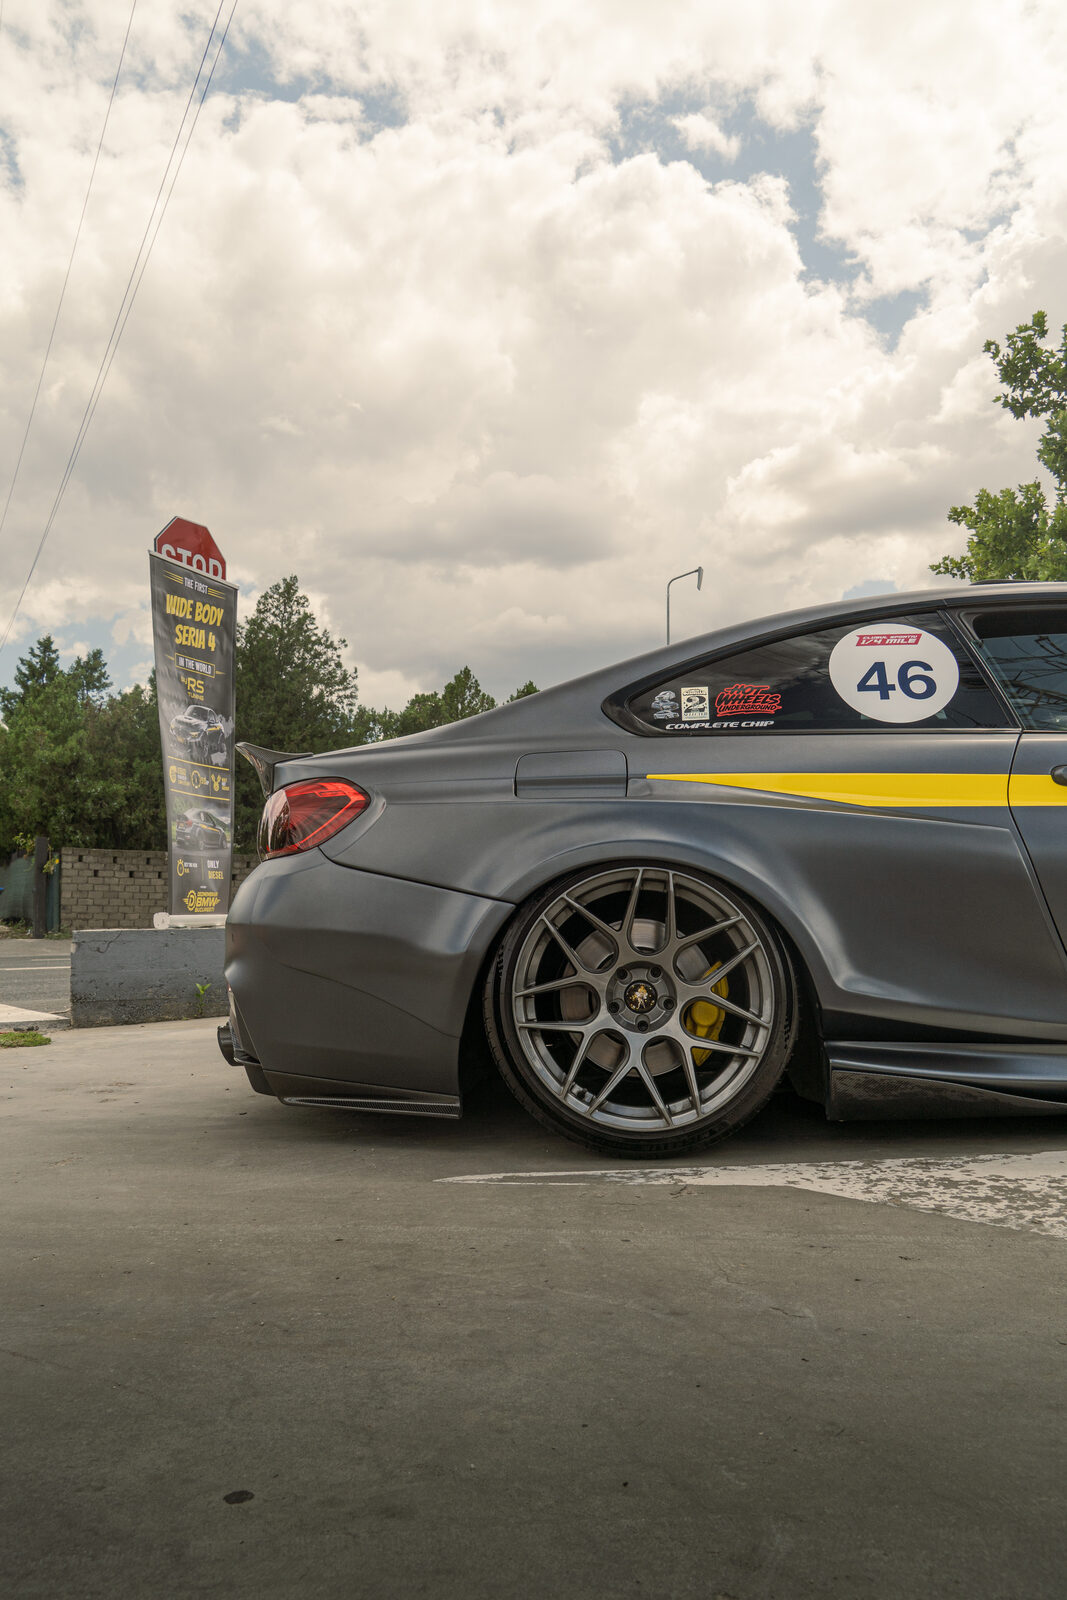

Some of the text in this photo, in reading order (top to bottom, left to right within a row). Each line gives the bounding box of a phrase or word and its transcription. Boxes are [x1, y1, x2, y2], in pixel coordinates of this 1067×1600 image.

[184, 577, 208, 595] THE FIRST
[166, 593, 224, 627] WIDE BODY
[175, 624, 216, 652] SERIA 4
[178, 656, 212, 675] IN THE WORLD
[187, 677, 205, 694] RS
[856, 660, 937, 701] 46
[724, 684, 770, 696] HOT
[715, 692, 781, 706] WHEELS
[718, 703, 779, 713] UNDERGROUND
[665, 720, 775, 730] COMPLETE CHIP
[207, 860, 220, 869] ONLY
[208, 870, 224, 880] DIESEL
[196, 897, 218, 907] BMW
